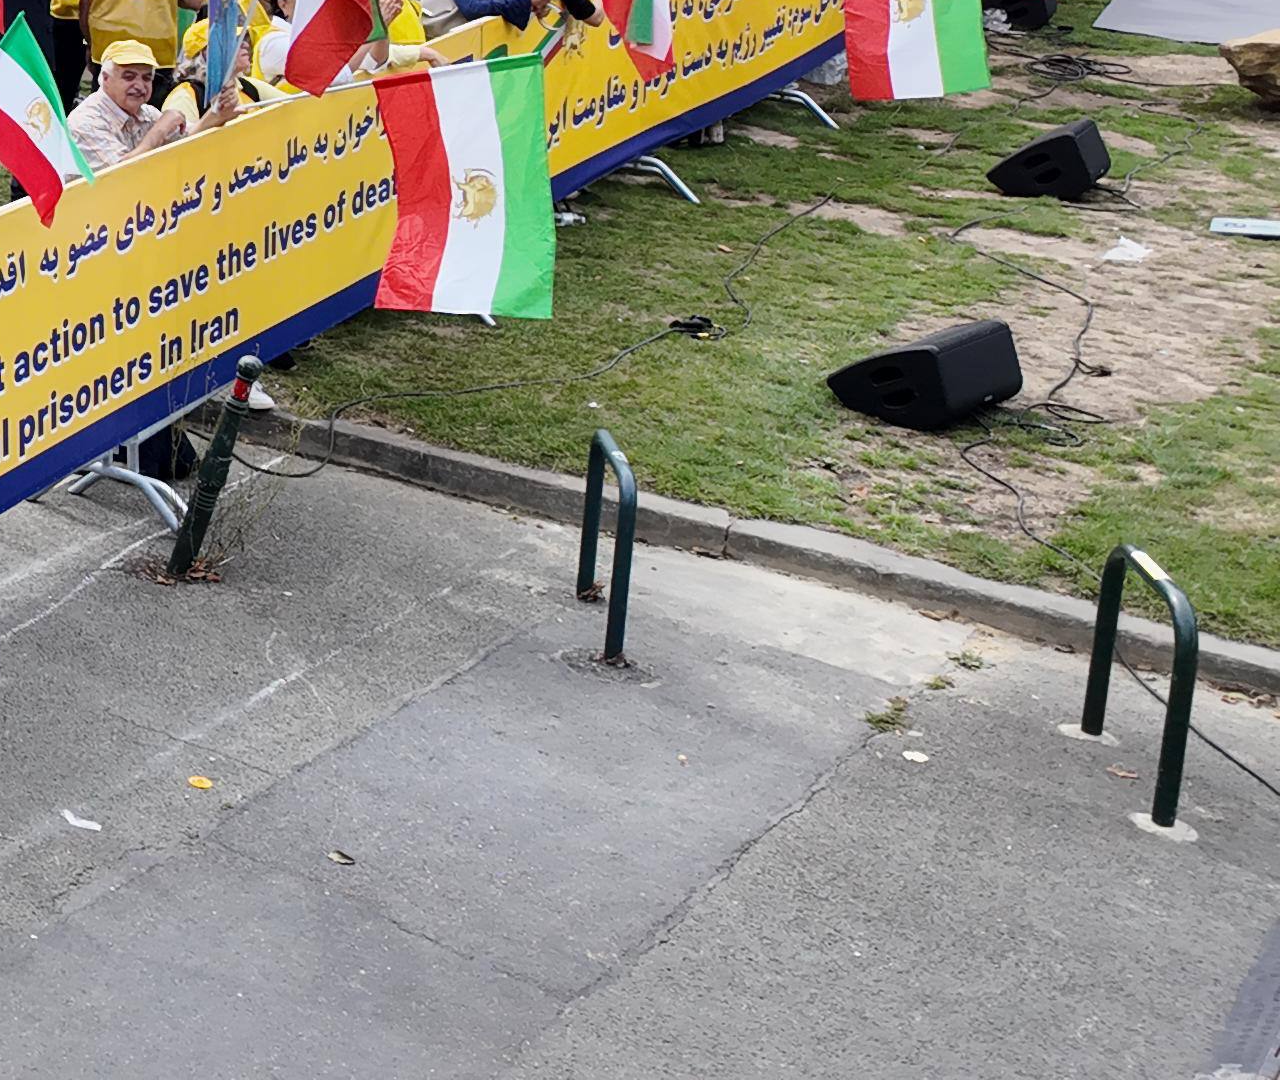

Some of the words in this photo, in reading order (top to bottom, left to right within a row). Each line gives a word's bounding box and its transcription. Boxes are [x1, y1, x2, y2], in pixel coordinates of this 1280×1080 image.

[210, 180, 223, 212] و
[12, 318, 106, 385] action
[112, 296, 142, 334] to
[147, 263, 210, 315] save
[216, 241, 258, 282] the
[263, 212, 318, 262] lives
[323, 190, 347, 231] of
[18, 350, 153, 457] prisoners
[160, 331, 184, 373] in
[191, 306, 240, 356] Iran
